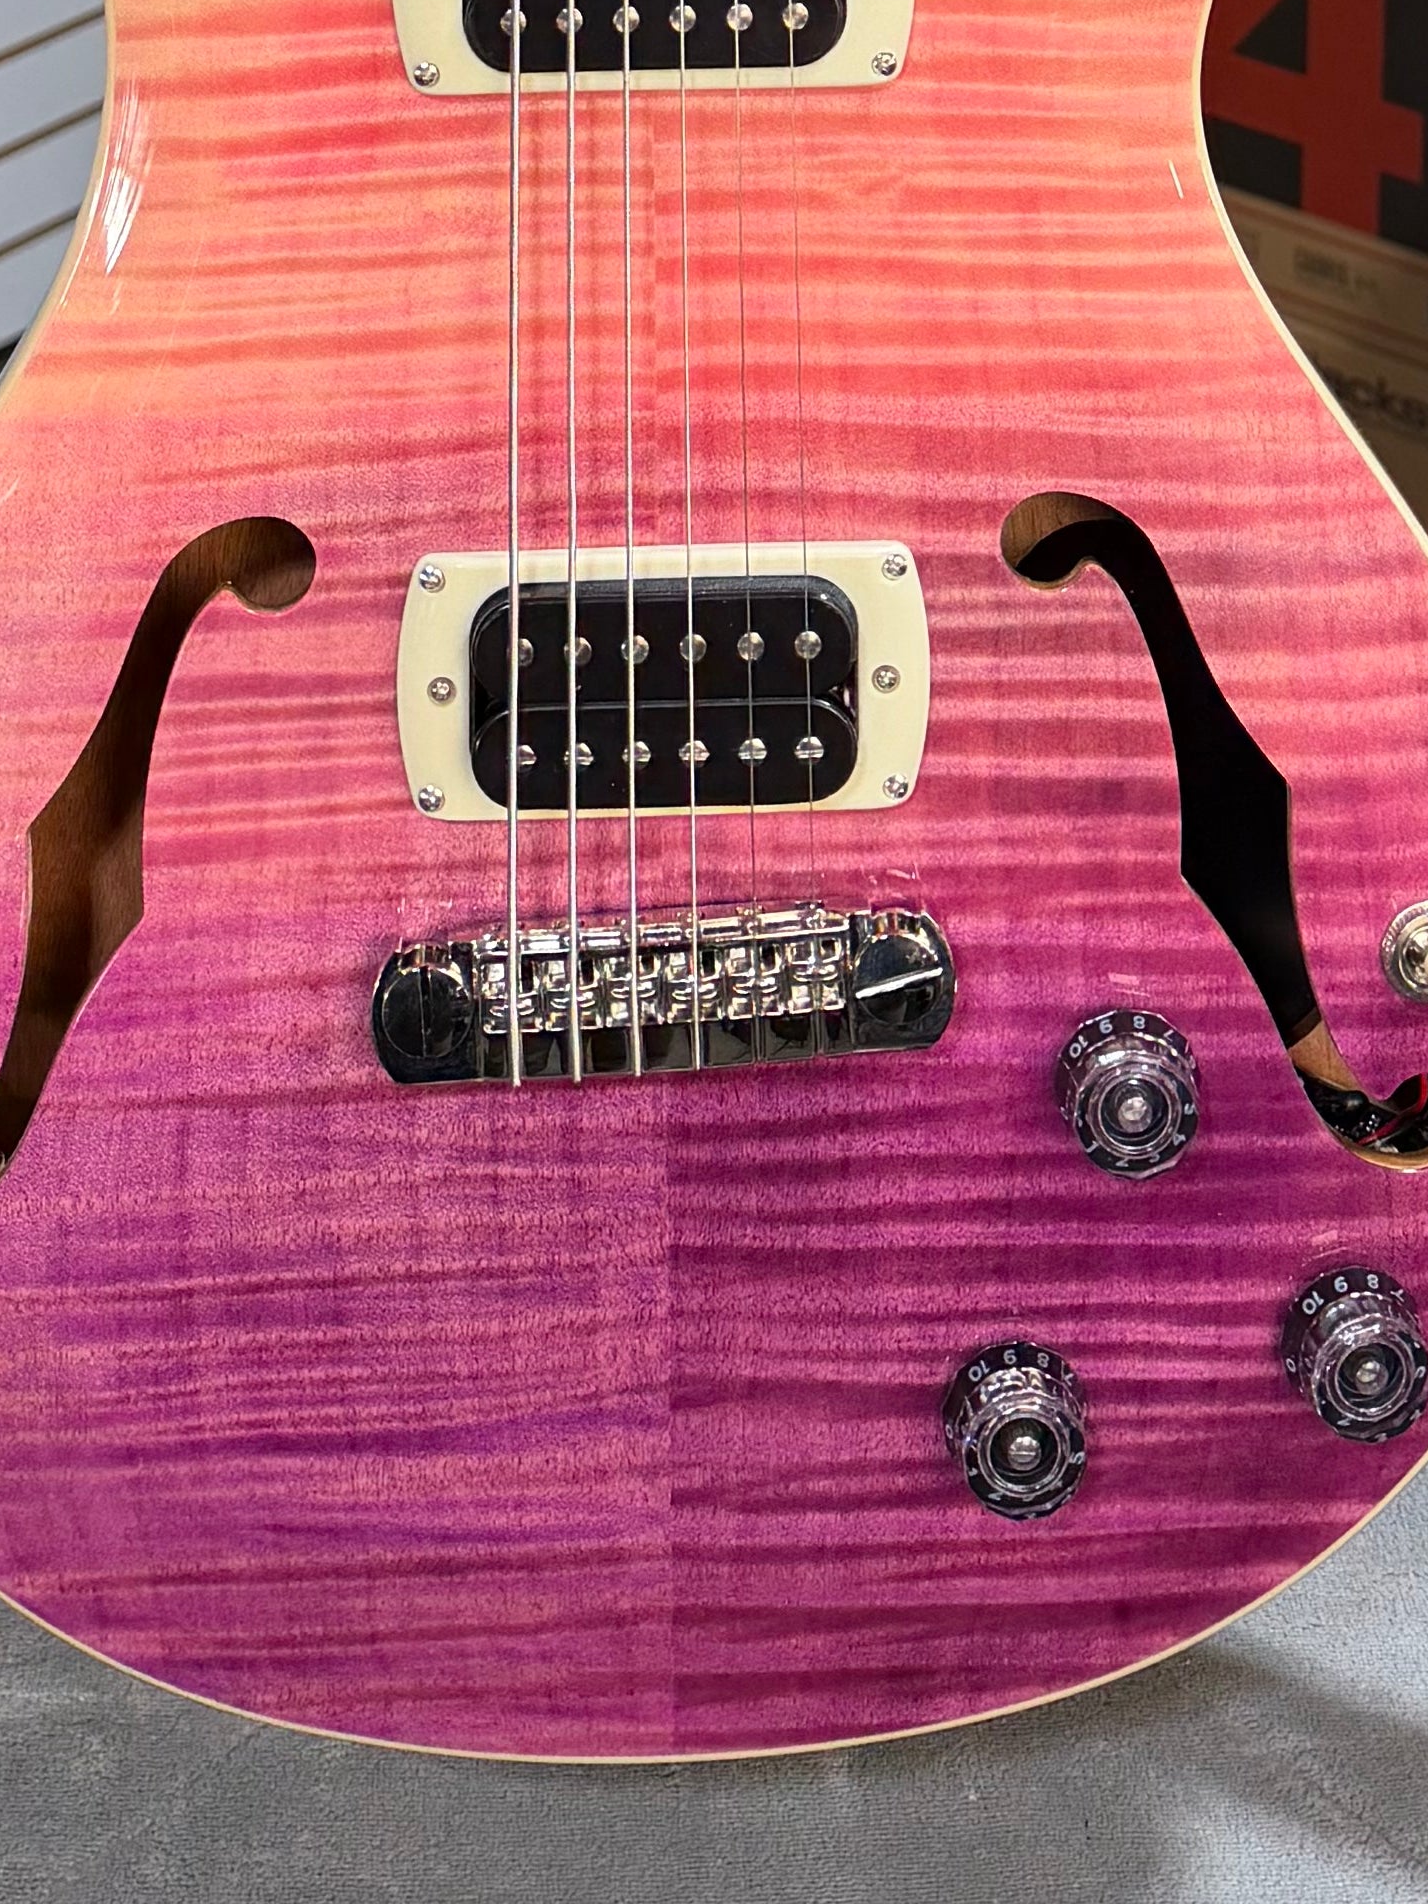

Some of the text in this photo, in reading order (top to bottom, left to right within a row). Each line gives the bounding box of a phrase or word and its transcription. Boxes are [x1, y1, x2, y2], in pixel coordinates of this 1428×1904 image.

[1068, 1035, 1089, 1059] 10
[1098, 1018, 1113, 1034] 9
[1132, 1014, 1146, 1030] 8
[1301, 1290, 1325, 1316] 10
[1333, 1275, 1349, 1293] 9
[1366, 1273, 1380, 1290] 8
[967, 1359, 991, 1383] 10
[1003, 1348, 1018, 1365] 9
[1036, 1351, 1051, 1369] 8
